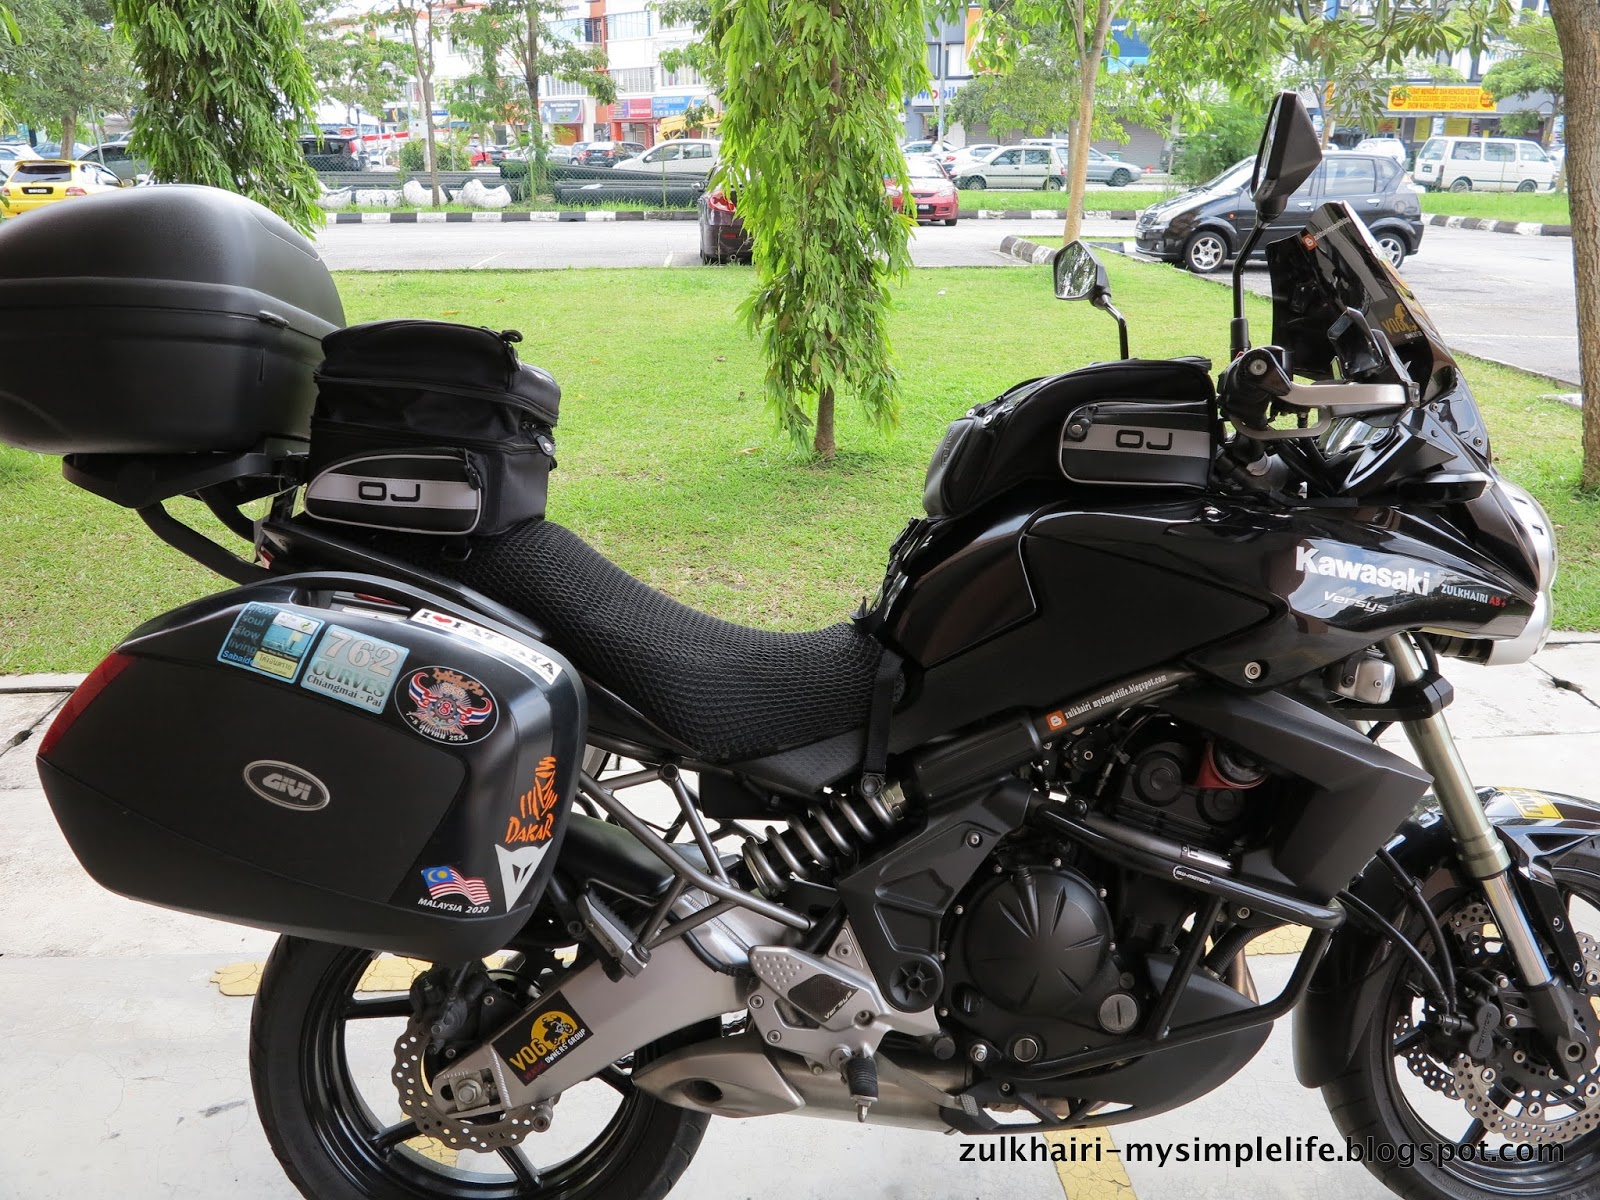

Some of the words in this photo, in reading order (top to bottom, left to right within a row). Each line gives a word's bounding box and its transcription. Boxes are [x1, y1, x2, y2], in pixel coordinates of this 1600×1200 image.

[1116, 430, 1173, 450] OJ
[358, 481, 421, 502] OJ
[1296, 546, 1430, 596] Kawasaki
[1324, 591, 1389, 612] Versys
[1440, 584, 1489, 604] ZULKHAIRI
[229, 638, 258, 657] living
[325, 630, 398, 677] 762
[421, 611, 431, 619] I
[453, 621, 555, 677] PATAYA
[313, 661, 388, 698] CURVES
[307, 674, 358, 699] Chiangmai
[366, 695, 382, 707] Pai
[439, 701, 452, 716] 8
[1064, 701, 1092, 720] zulkhairi
[505, 813, 555, 843] DAKAR
[418, 898, 462, 912] MALAYSIA
[465, 905, 490, 914] 2020
[567, 1028, 587, 1046] GROUP
[509, 1039, 548, 1071] VOG
